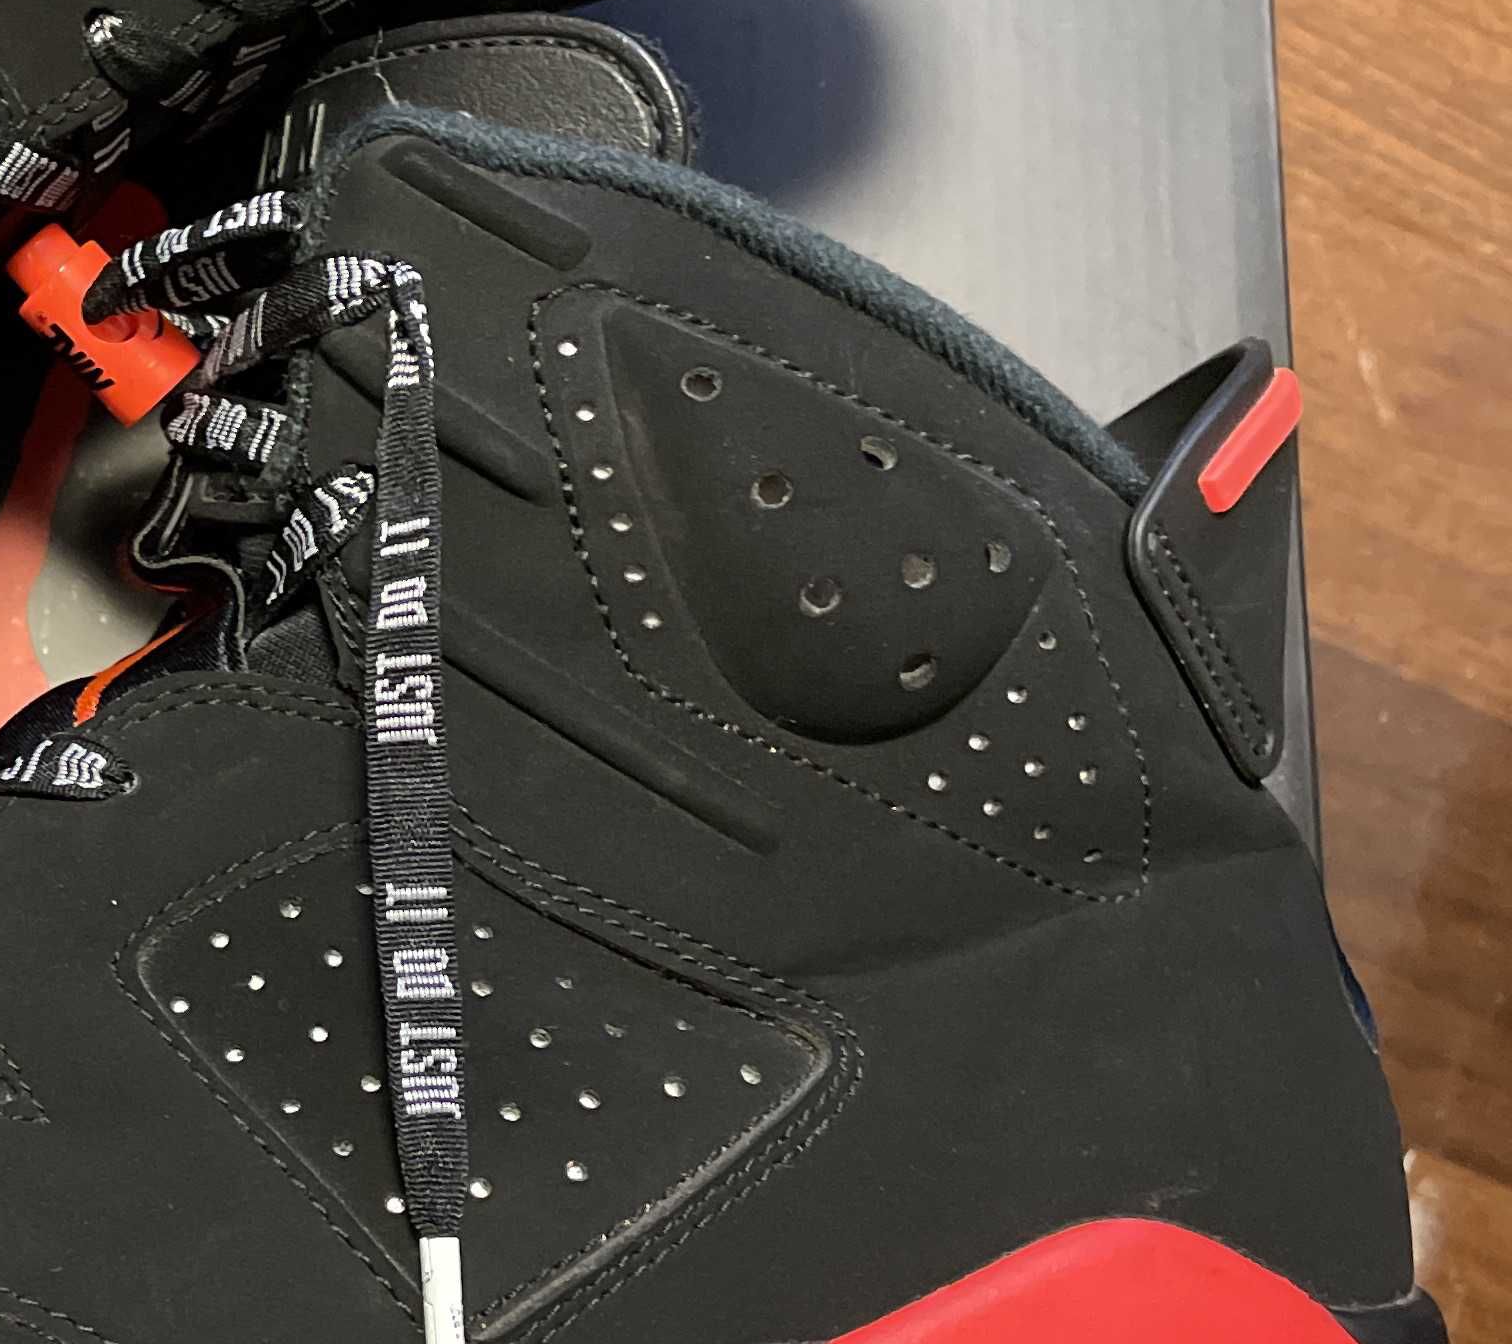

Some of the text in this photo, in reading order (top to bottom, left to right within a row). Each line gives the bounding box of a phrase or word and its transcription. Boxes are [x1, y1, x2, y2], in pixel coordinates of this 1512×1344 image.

[248, 408, 287, 463] IT
[374, 517, 438, 747] JUST DO IT
[386, 882, 463, 1120] JUST DO IT
